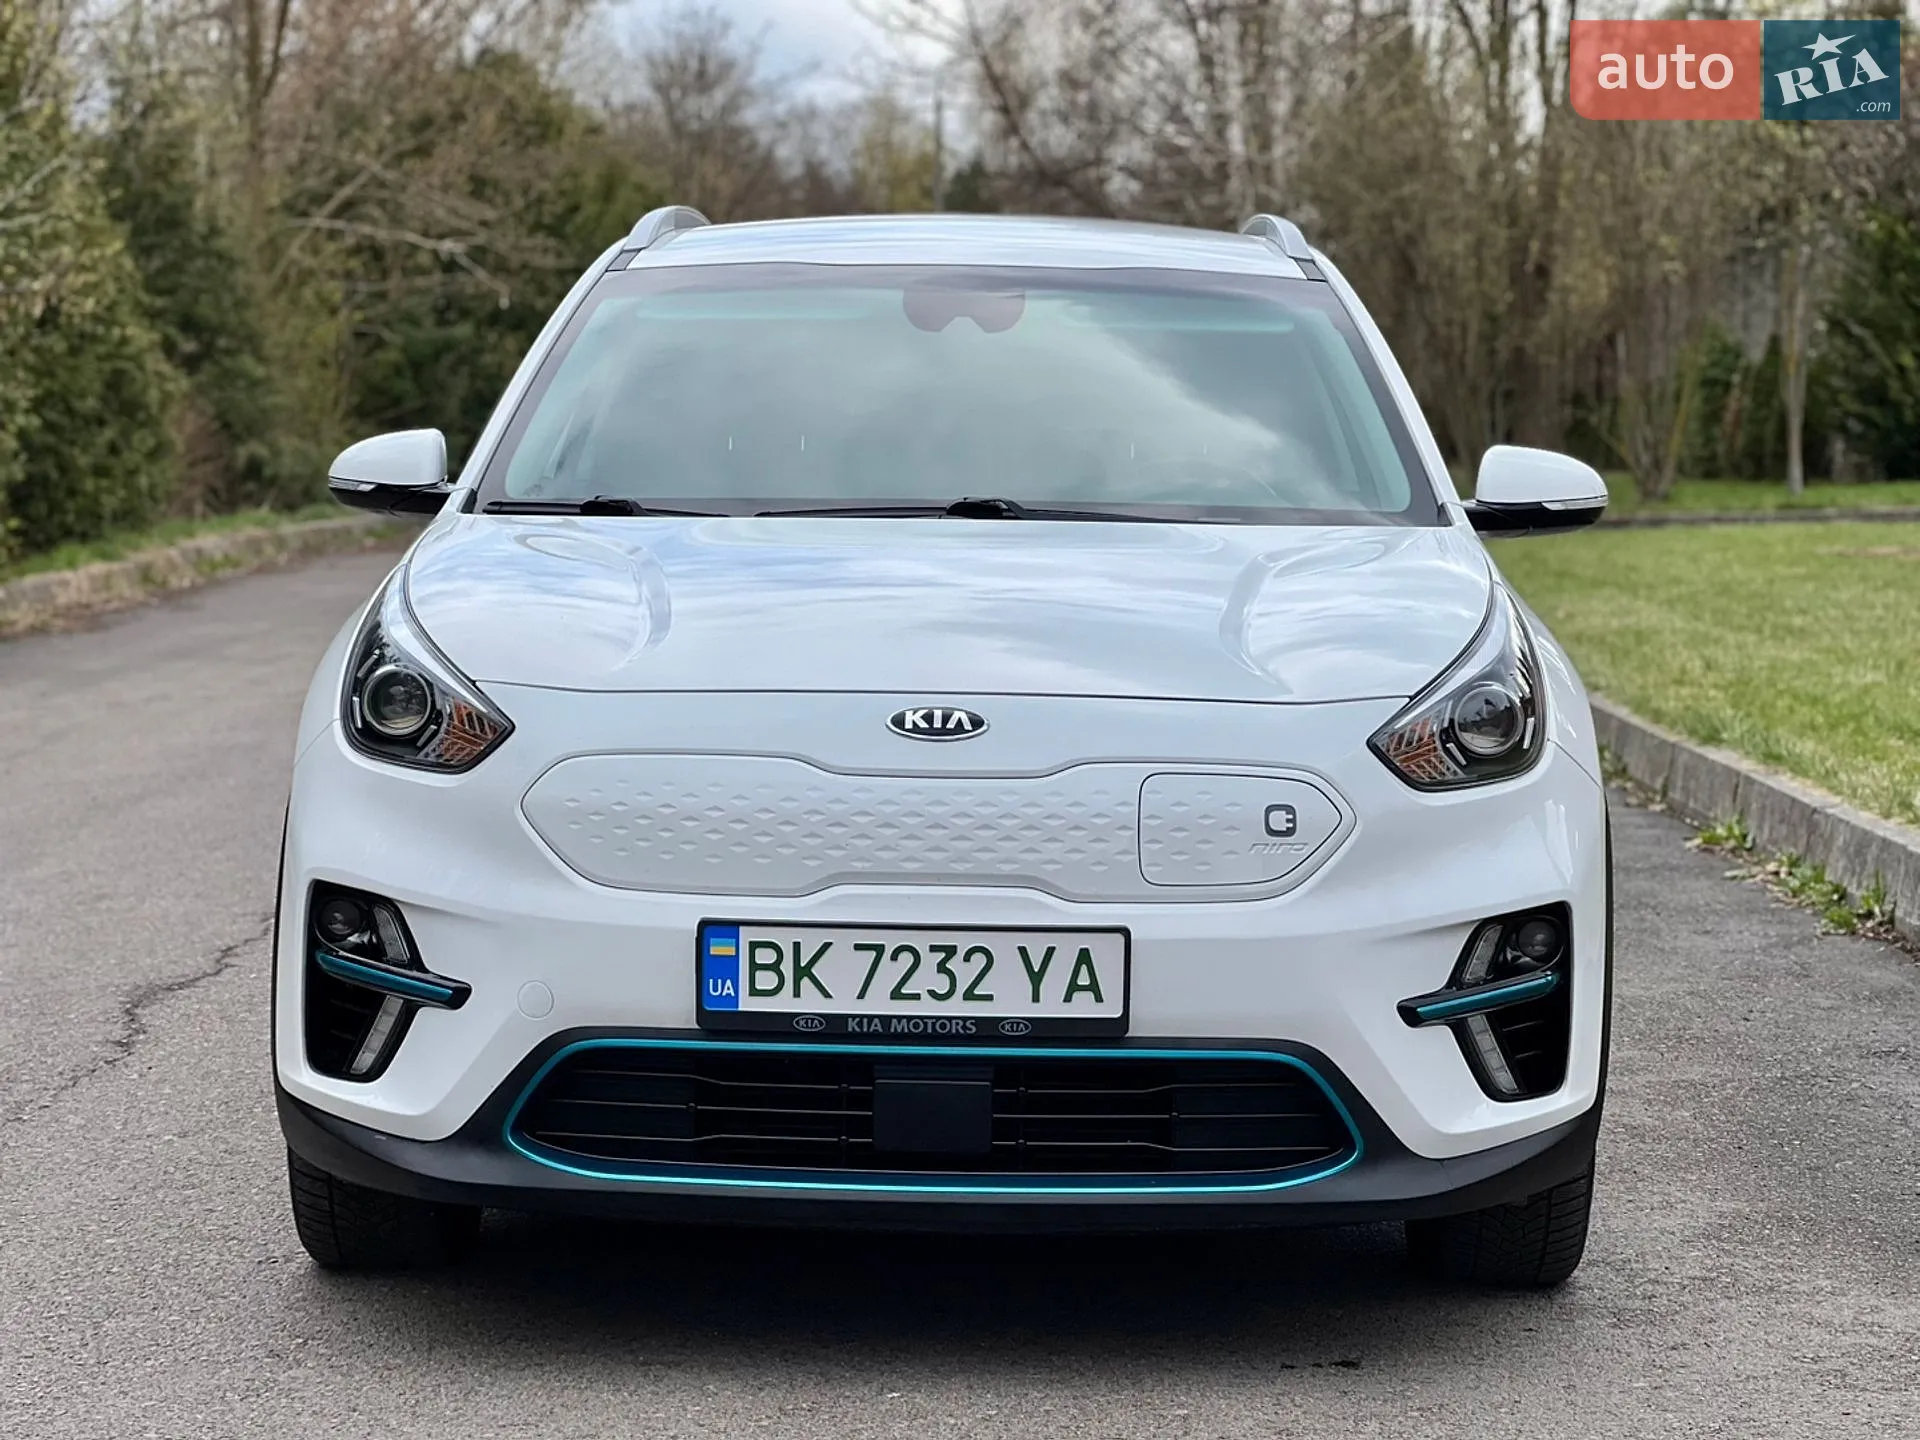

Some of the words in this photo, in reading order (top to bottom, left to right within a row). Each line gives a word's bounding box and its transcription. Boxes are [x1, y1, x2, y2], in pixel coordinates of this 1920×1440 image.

[904, 709, 973, 731] KIA
[748, 940, 833, 999] BK
[853, 943, 995, 1001] 7232
[1017, 945, 1105, 1004] YA
[709, 979, 735, 997] UA
[798, 1017, 821, 1029] KIA
[847, 1017, 883, 1033] KIA
[889, 1018, 977, 1035] MOTORS
[1004, 1021, 1027, 1033] KIA
